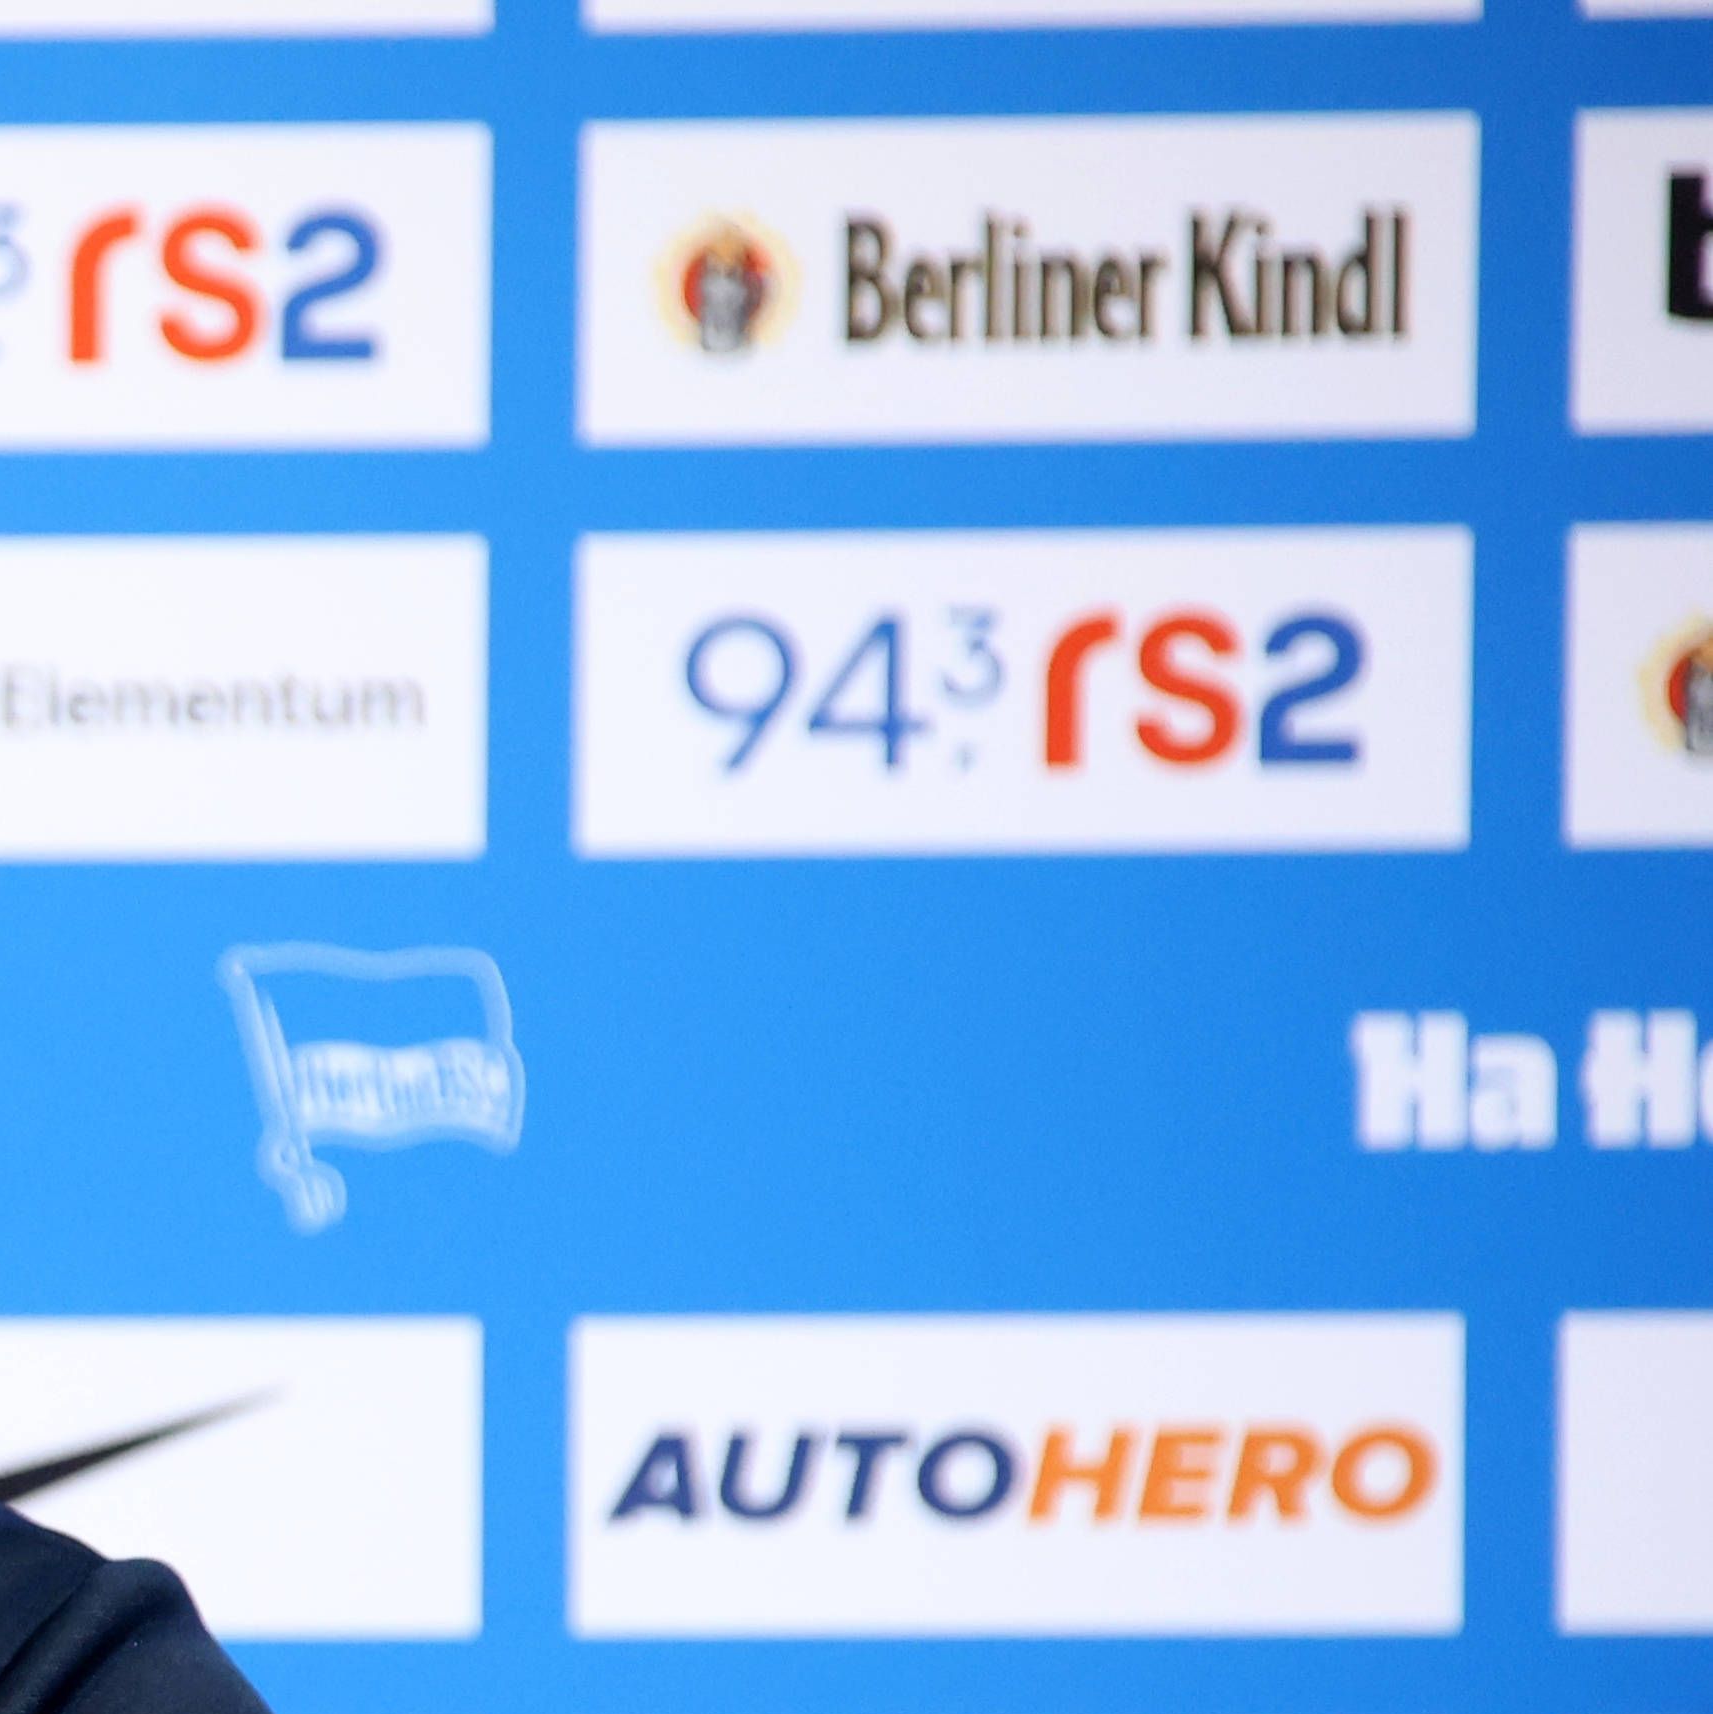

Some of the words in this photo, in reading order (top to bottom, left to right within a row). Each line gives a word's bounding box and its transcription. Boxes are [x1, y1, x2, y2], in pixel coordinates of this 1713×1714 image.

[65, 206, 384, 366] rs2
[843, 214, 1167, 346] Berliner
[1186, 208, 1410, 343] Kindl
[1040, 610, 1365, 771] rs2
[1348, 1009, 1558, 1153] Ha
[1579, 1008, 1713, 1151] H
[609, 1422, 1439, 1524] AUTOHERO
